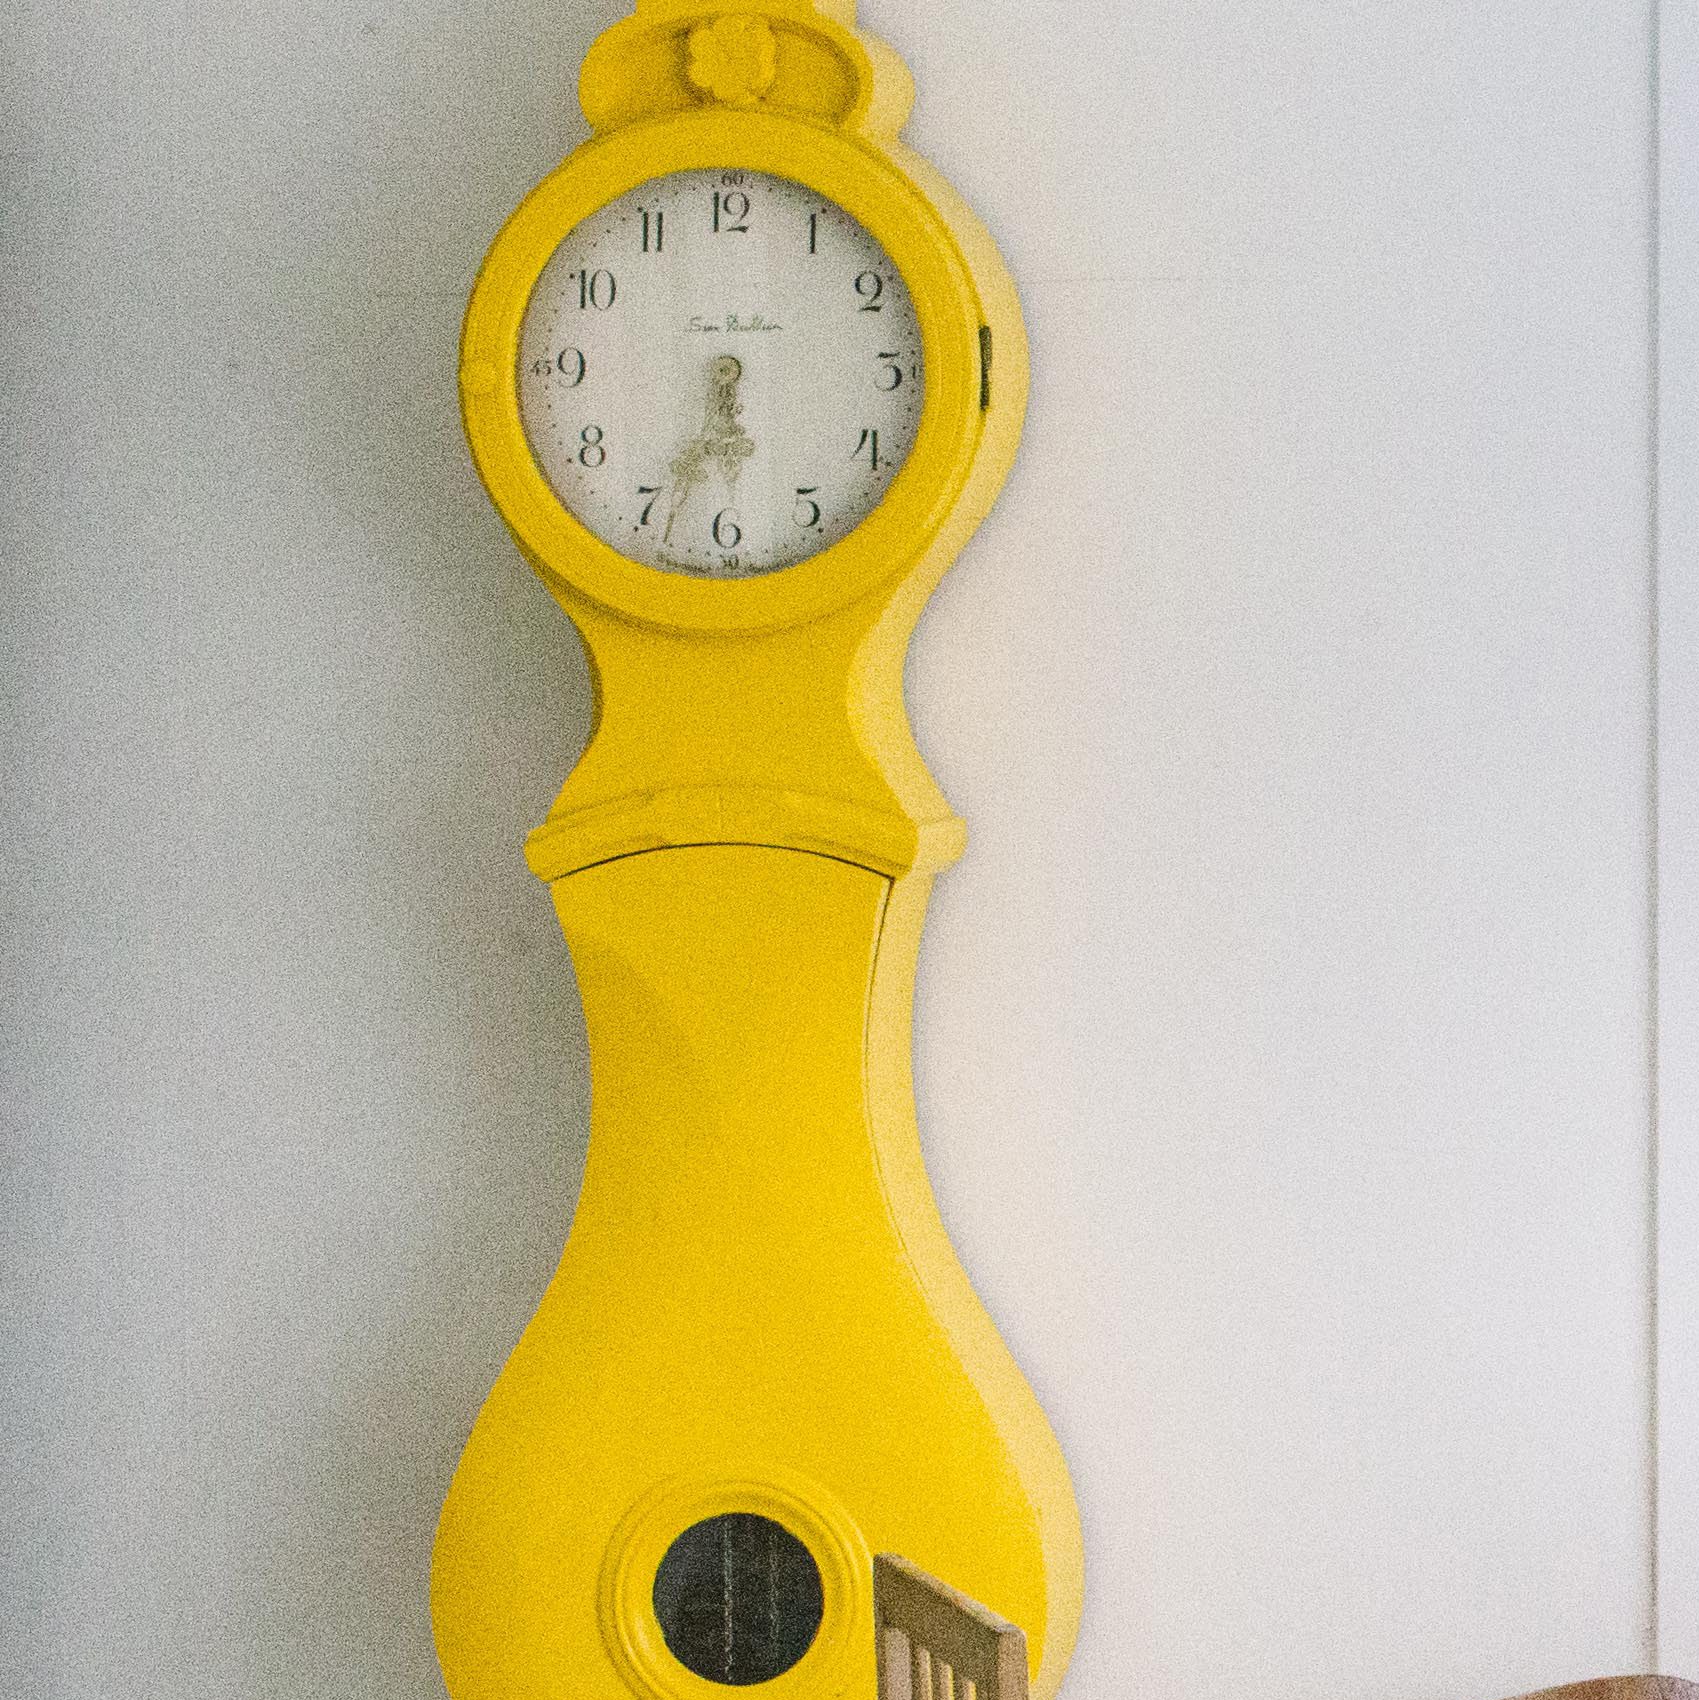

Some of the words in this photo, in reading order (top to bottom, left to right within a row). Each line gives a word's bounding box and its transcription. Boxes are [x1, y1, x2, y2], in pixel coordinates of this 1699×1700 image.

[641, 209, 664, 253] 11
[712, 191, 750, 234] 12
[809, 213, 818, 255] 1
[578, 269, 617, 311] 10
[853, 271, 883, 313] 2
[556, 346, 586, 388] 9
[875, 351, 904, 392] 3
[578, 425, 606, 468] 8
[852, 428, 879, 471] 4
[637, 485, 661, 526] 7
[794, 486, 821, 528] 5
[711, 507, 742, 549] 6
